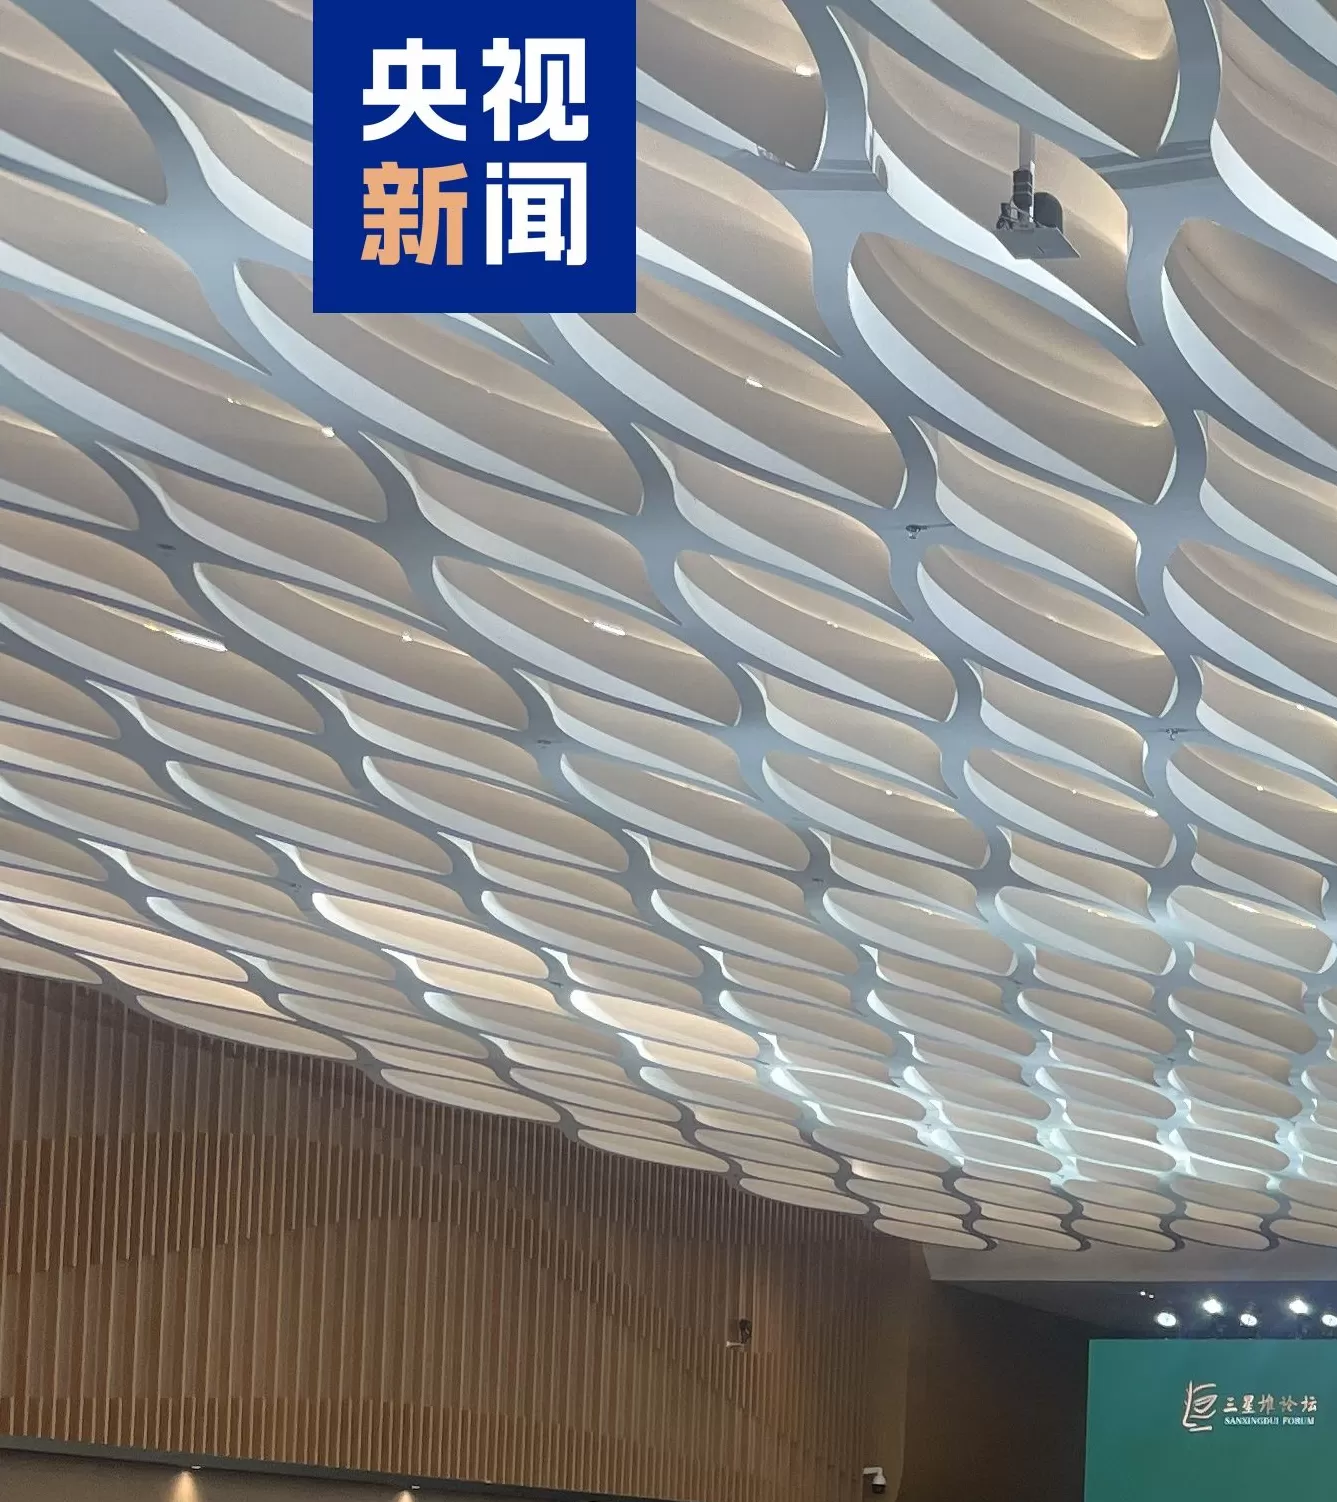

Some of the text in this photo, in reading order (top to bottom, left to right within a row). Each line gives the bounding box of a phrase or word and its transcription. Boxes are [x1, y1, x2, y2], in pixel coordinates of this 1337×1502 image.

[1223, 1394, 1317, 1414] 三星堆论坛
[1224, 1417, 1315, 1425] SANXINGDUI FORUM
